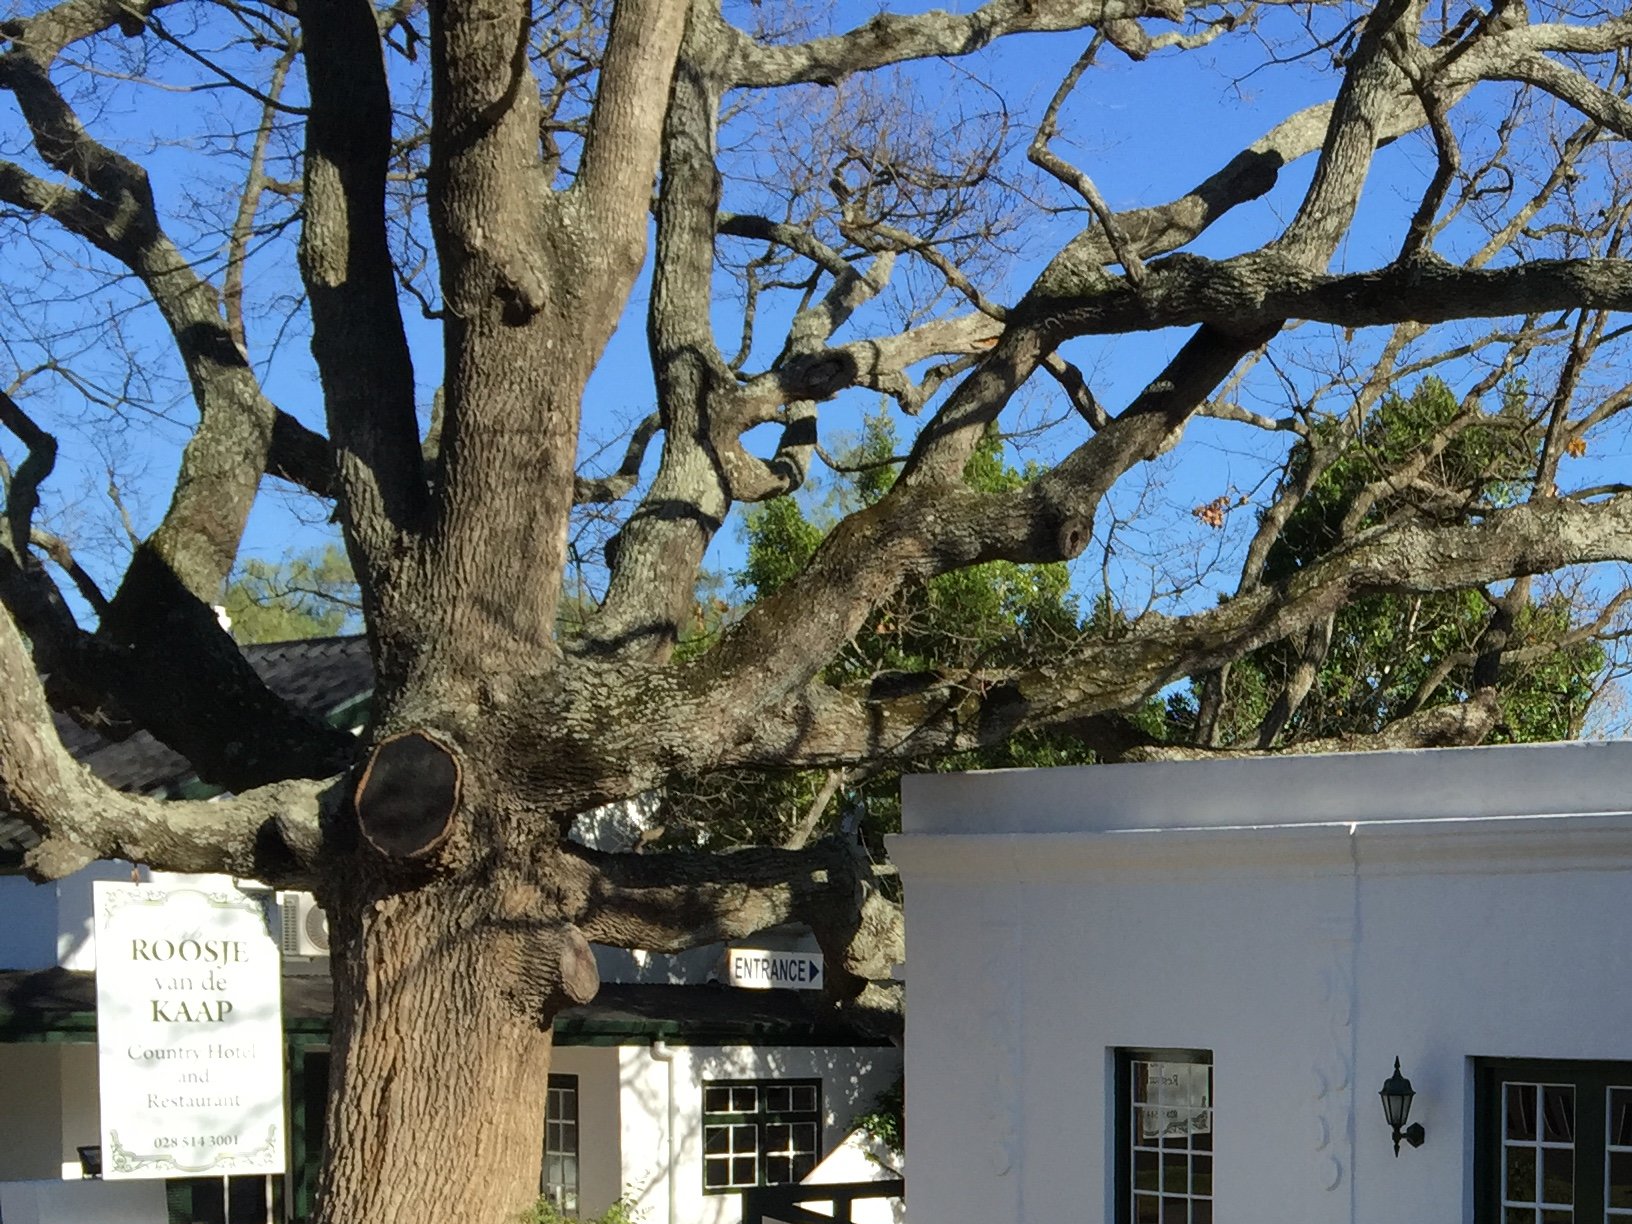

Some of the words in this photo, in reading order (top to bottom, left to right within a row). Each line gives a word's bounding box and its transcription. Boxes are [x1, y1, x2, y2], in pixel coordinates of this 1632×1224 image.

[132, 939, 249, 965] ROOSJE
[735, 957, 805, 981] ENTRANCE
[154, 976, 193, 991] van
[201, 969, 227, 992] de
[150, 999, 233, 1023] KAAP
[128, 1043, 200, 1063] Country
[208, 1043, 256, 1060] Hotel
[178, 1068, 209, 1084] and
[147, 1093, 241, 1109] Restaurant
[153, 1135, 178, 1149] 028
[182, 1135, 206, 1148] 514
[209, 1134, 238, 1147] 3001
